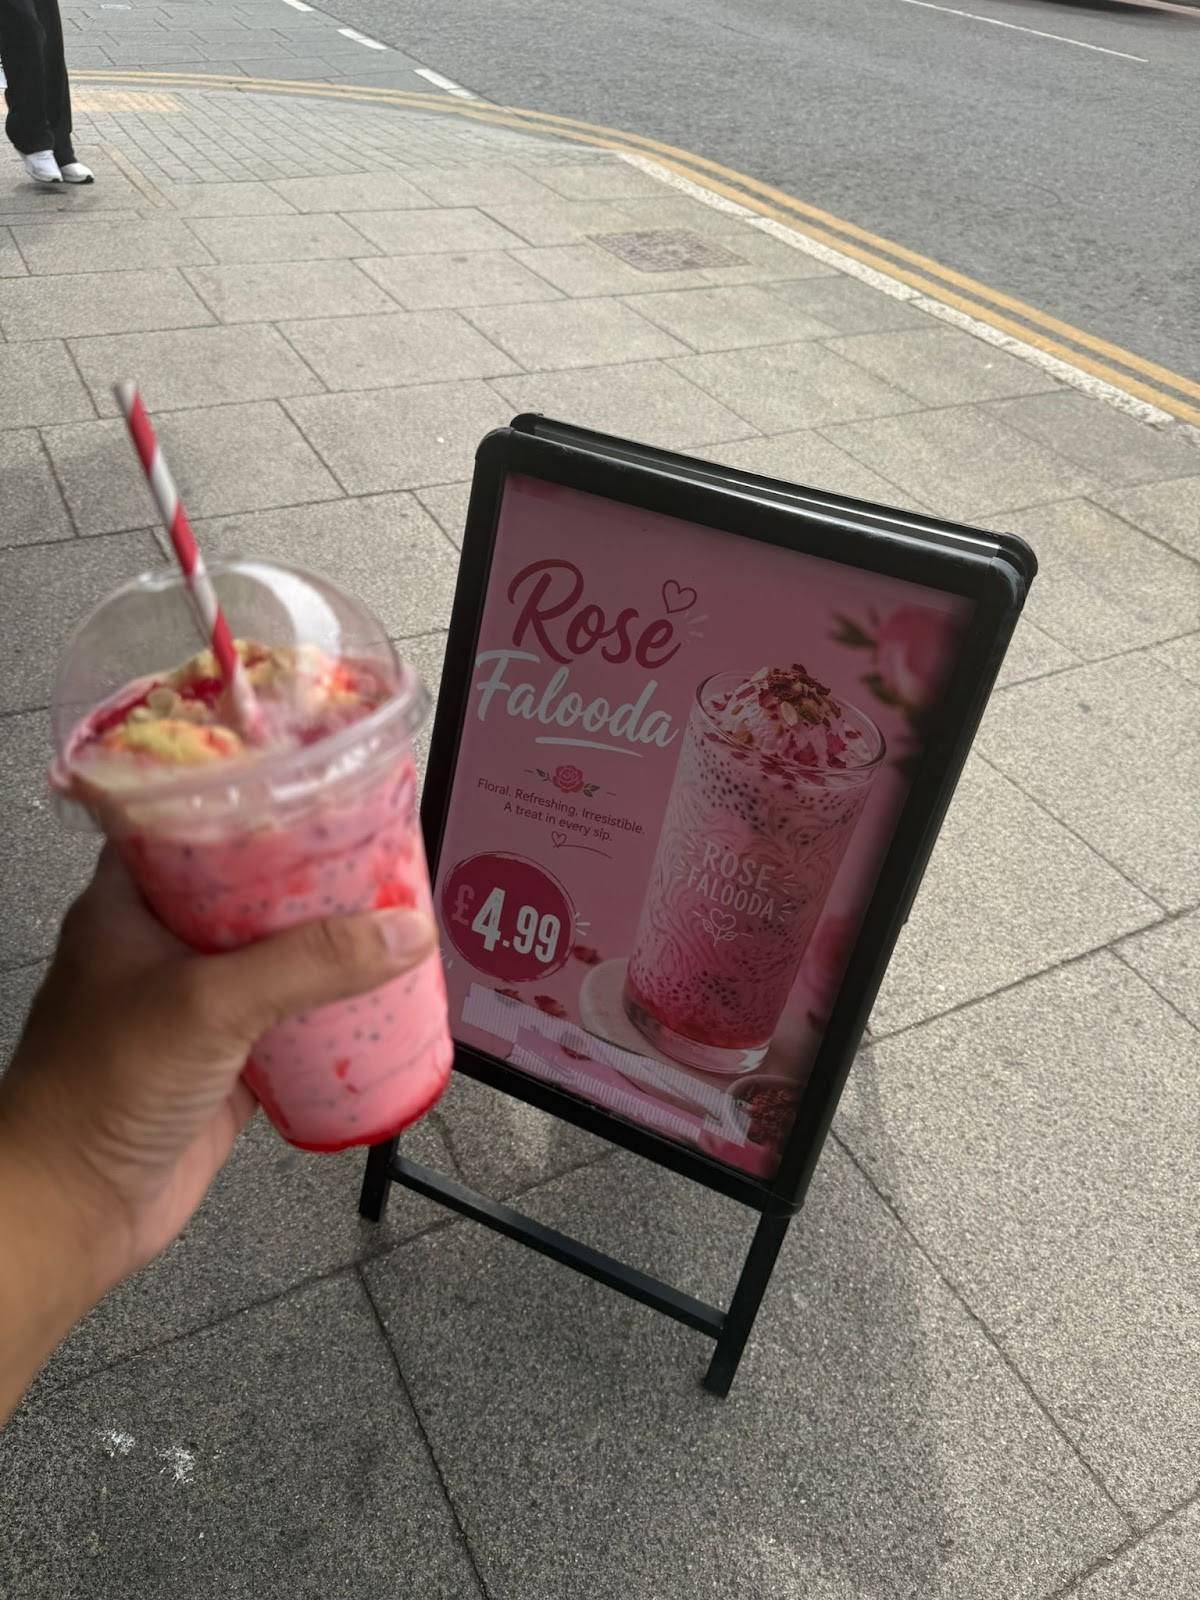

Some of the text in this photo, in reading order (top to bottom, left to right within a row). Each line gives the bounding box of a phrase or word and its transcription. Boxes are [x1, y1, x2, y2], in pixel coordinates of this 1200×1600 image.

[507, 558, 682, 669] Rose
[475, 649, 680, 748] Falooda
[477, 777, 646, 836] Floral. Refreshing. Irresistible.
[503, 801, 613, 842] A treat in every sip.
[687, 866, 774, 921] FALOODA
[702, 840, 776, 892] ROSE
[452, 884, 561, 964] £4.99
